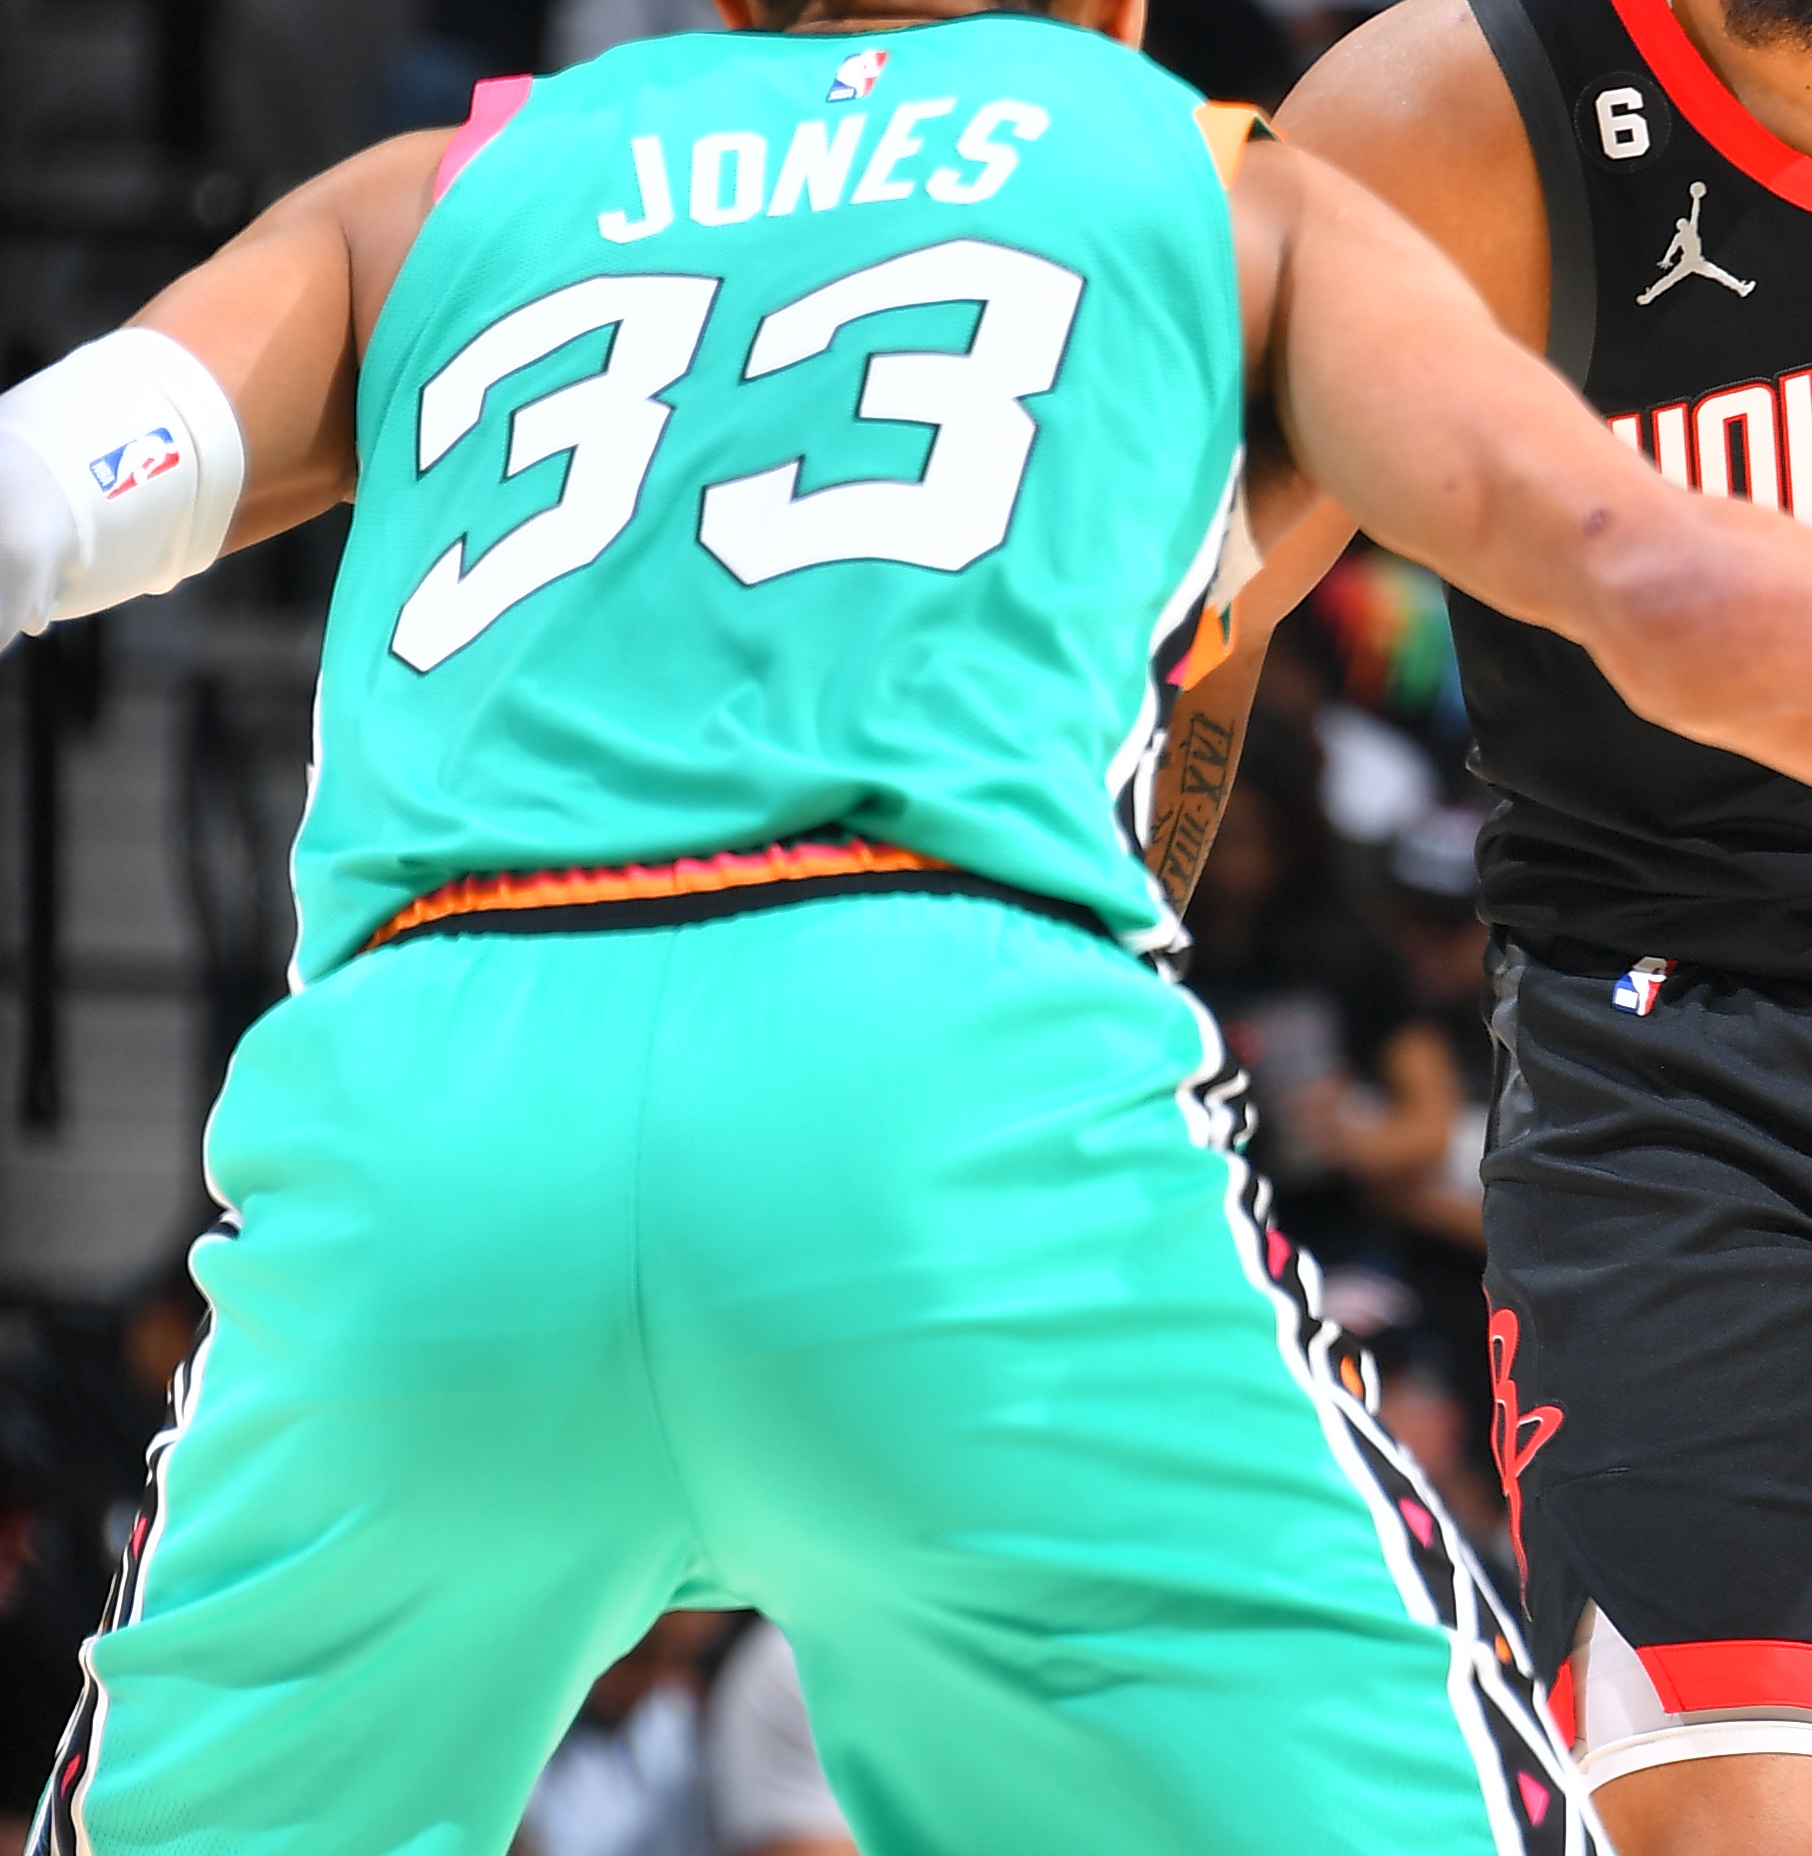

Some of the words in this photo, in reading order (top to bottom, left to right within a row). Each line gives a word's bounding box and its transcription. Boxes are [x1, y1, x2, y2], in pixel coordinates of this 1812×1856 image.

[598, 99, 1050, 245] JONES
[1595, 86, 1651, 160] 6
[389, 238, 1087, 675] 33
